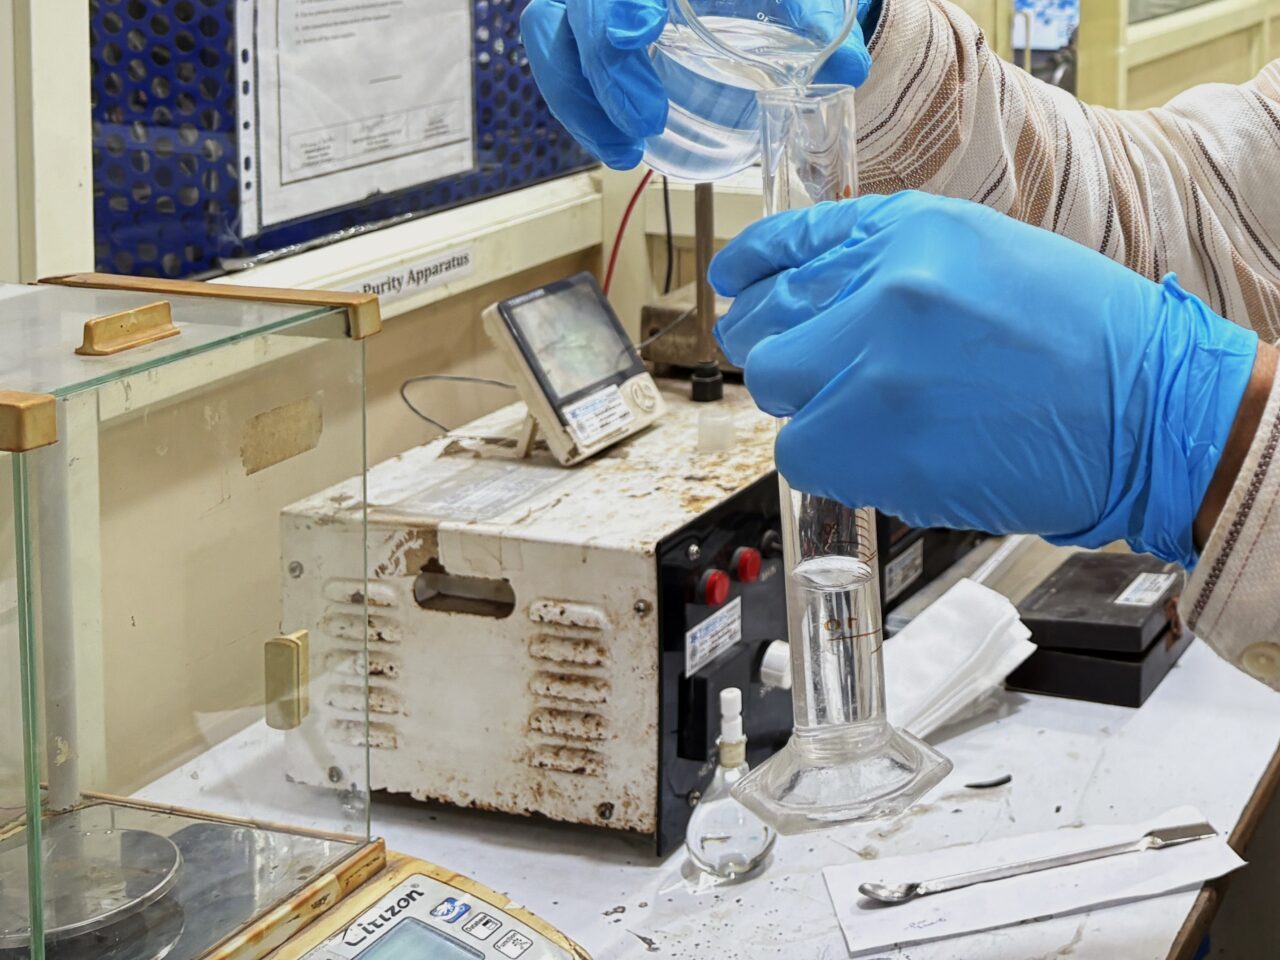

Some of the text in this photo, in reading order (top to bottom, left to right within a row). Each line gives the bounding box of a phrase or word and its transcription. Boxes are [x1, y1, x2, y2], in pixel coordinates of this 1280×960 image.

[363, 253, 470, 295] Purity Apparatus
[465, 915, 487, 932] Database
[496, 932, 518, 950] Function
